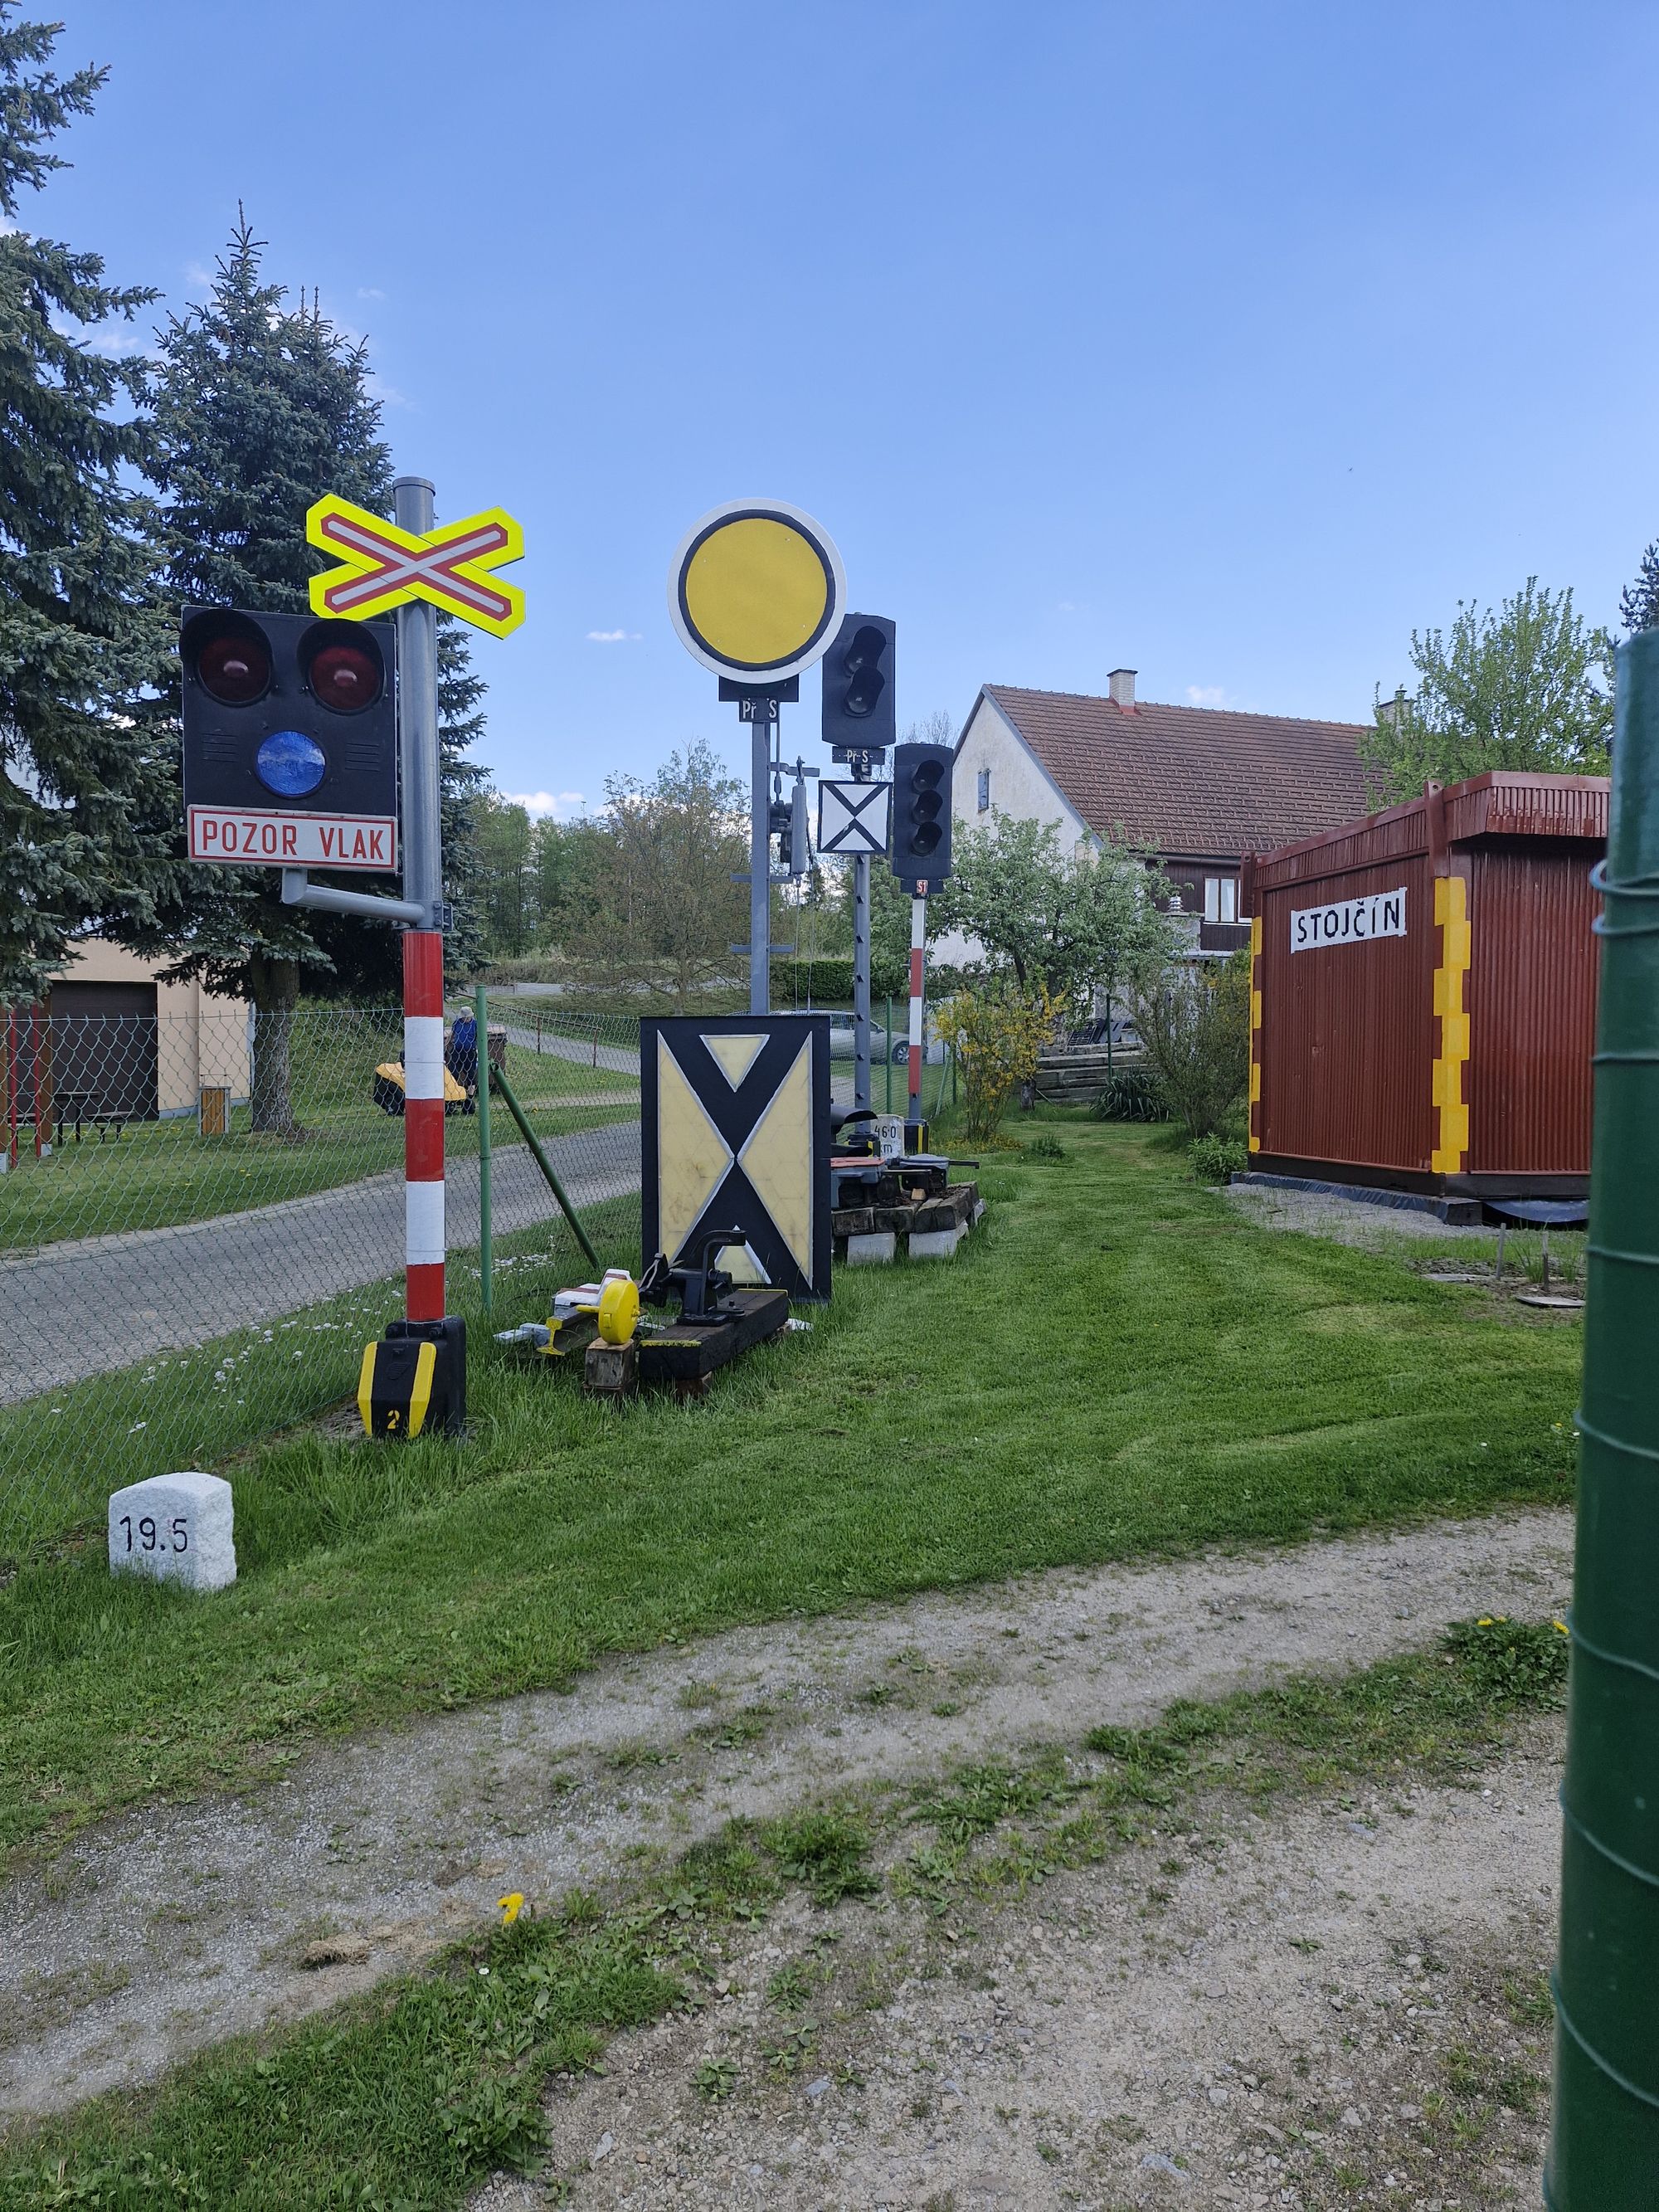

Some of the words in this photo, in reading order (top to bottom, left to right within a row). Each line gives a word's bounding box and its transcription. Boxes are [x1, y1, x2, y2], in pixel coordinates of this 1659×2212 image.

[742, 700, 757, 719] Př
[769, 700, 776, 719] S
[862, 750, 868, 763] S
[202, 820, 298, 855] POZOR
[319, 826, 384, 860] VLAK
[917, 881, 926, 892] S1
[1297, 897, 1399, 943] STOJČÍN
[387, 1410, 401, 1430] 2
[119, 1516, 187, 1552] 19.5
